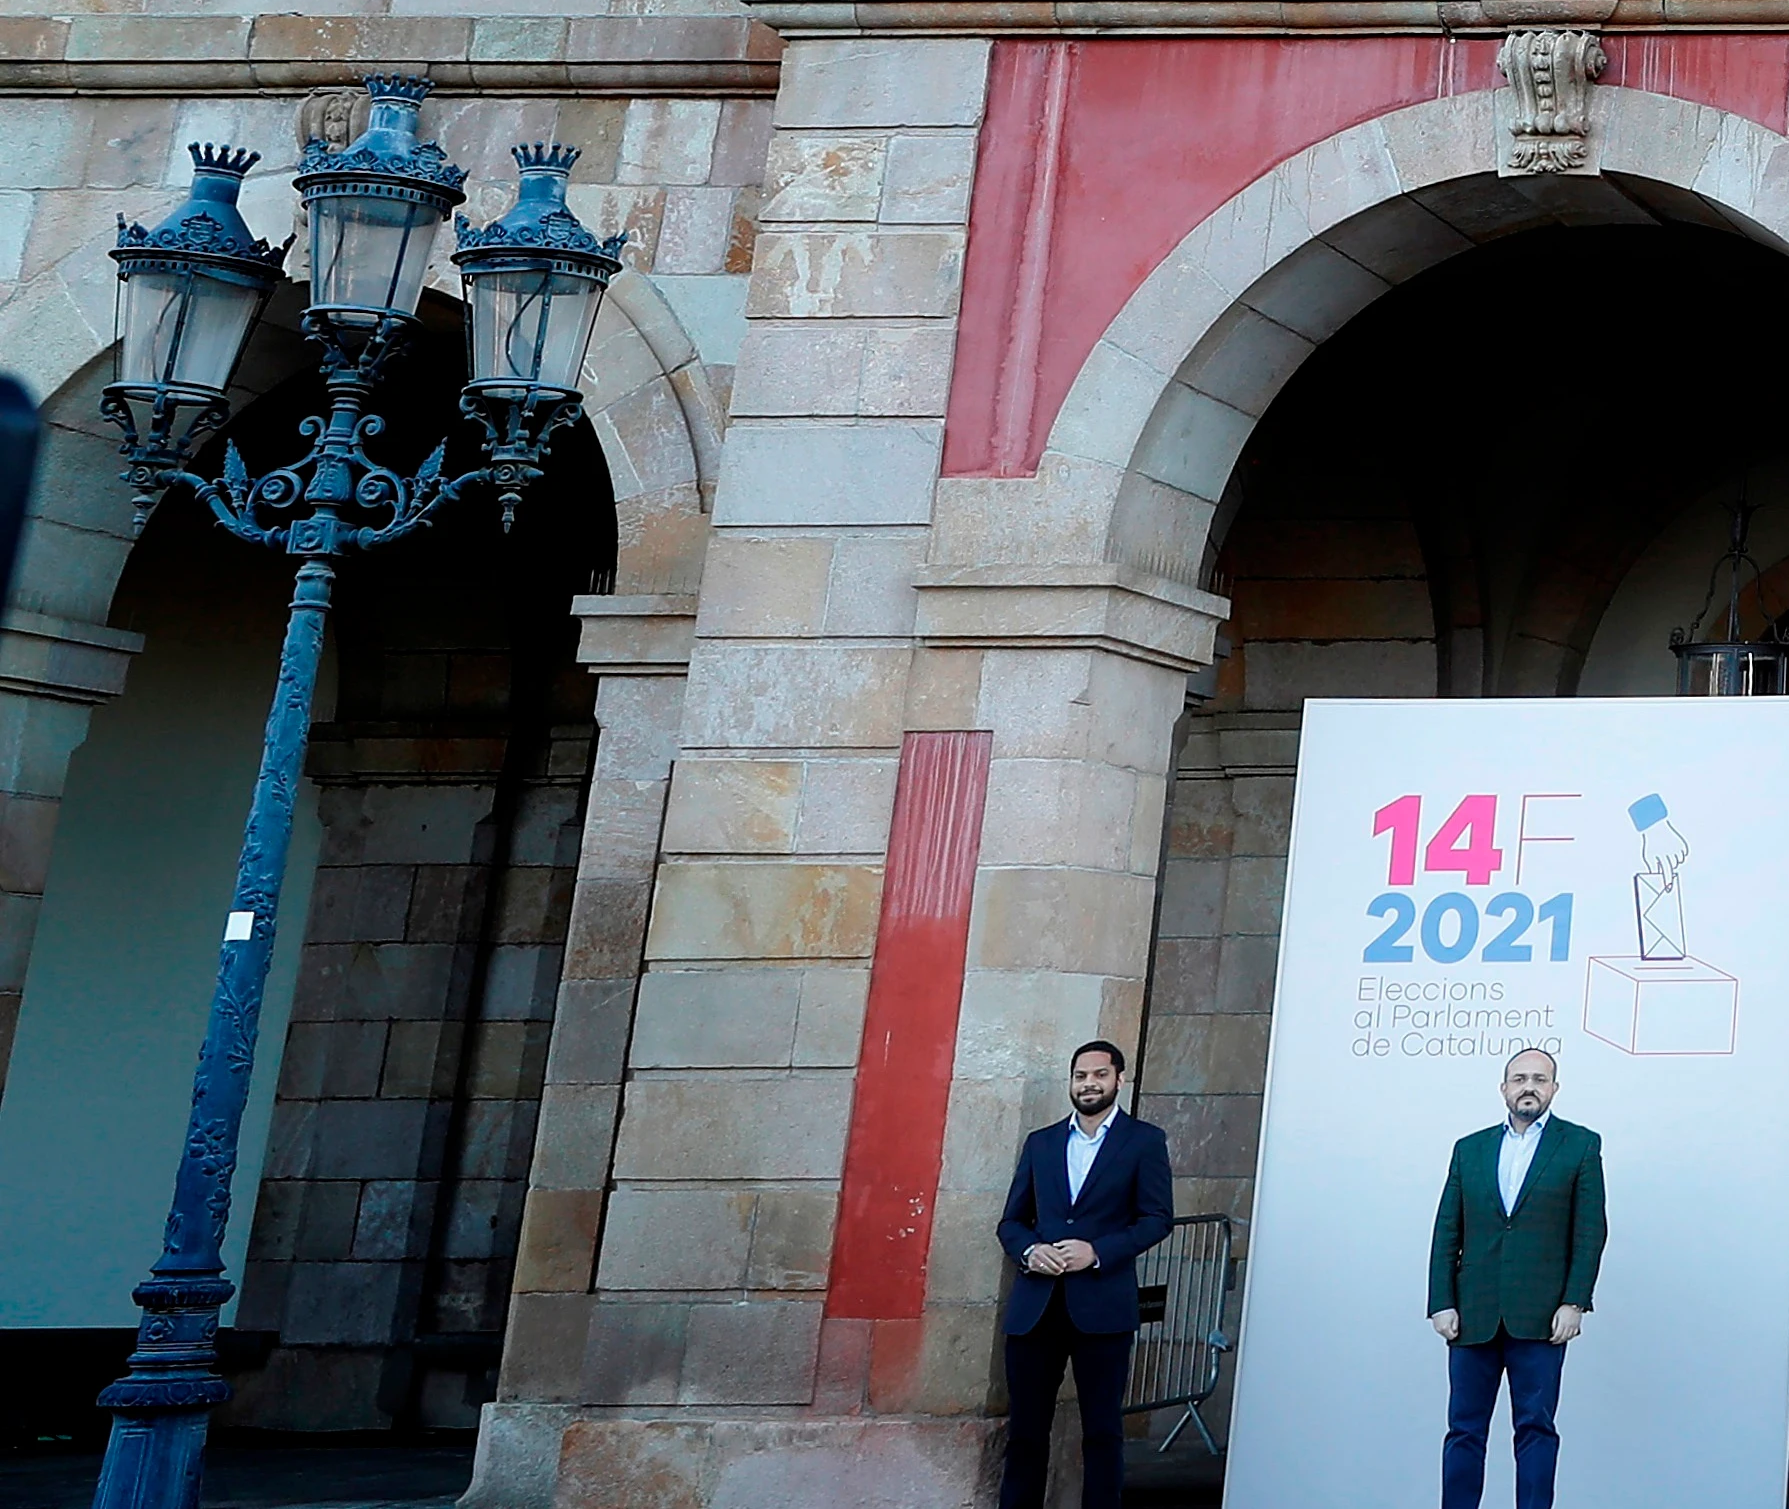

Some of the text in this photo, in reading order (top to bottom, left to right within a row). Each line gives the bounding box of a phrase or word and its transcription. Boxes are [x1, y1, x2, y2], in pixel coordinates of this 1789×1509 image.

[1373, 794, 1582, 886] 14F
[1363, 892, 1573, 963] 2021
[1358, 977, 1504, 1002] Eleccions
[1353, 1003, 1554, 1029] al Parlament
[1351, 1031, 1391, 1057] de
